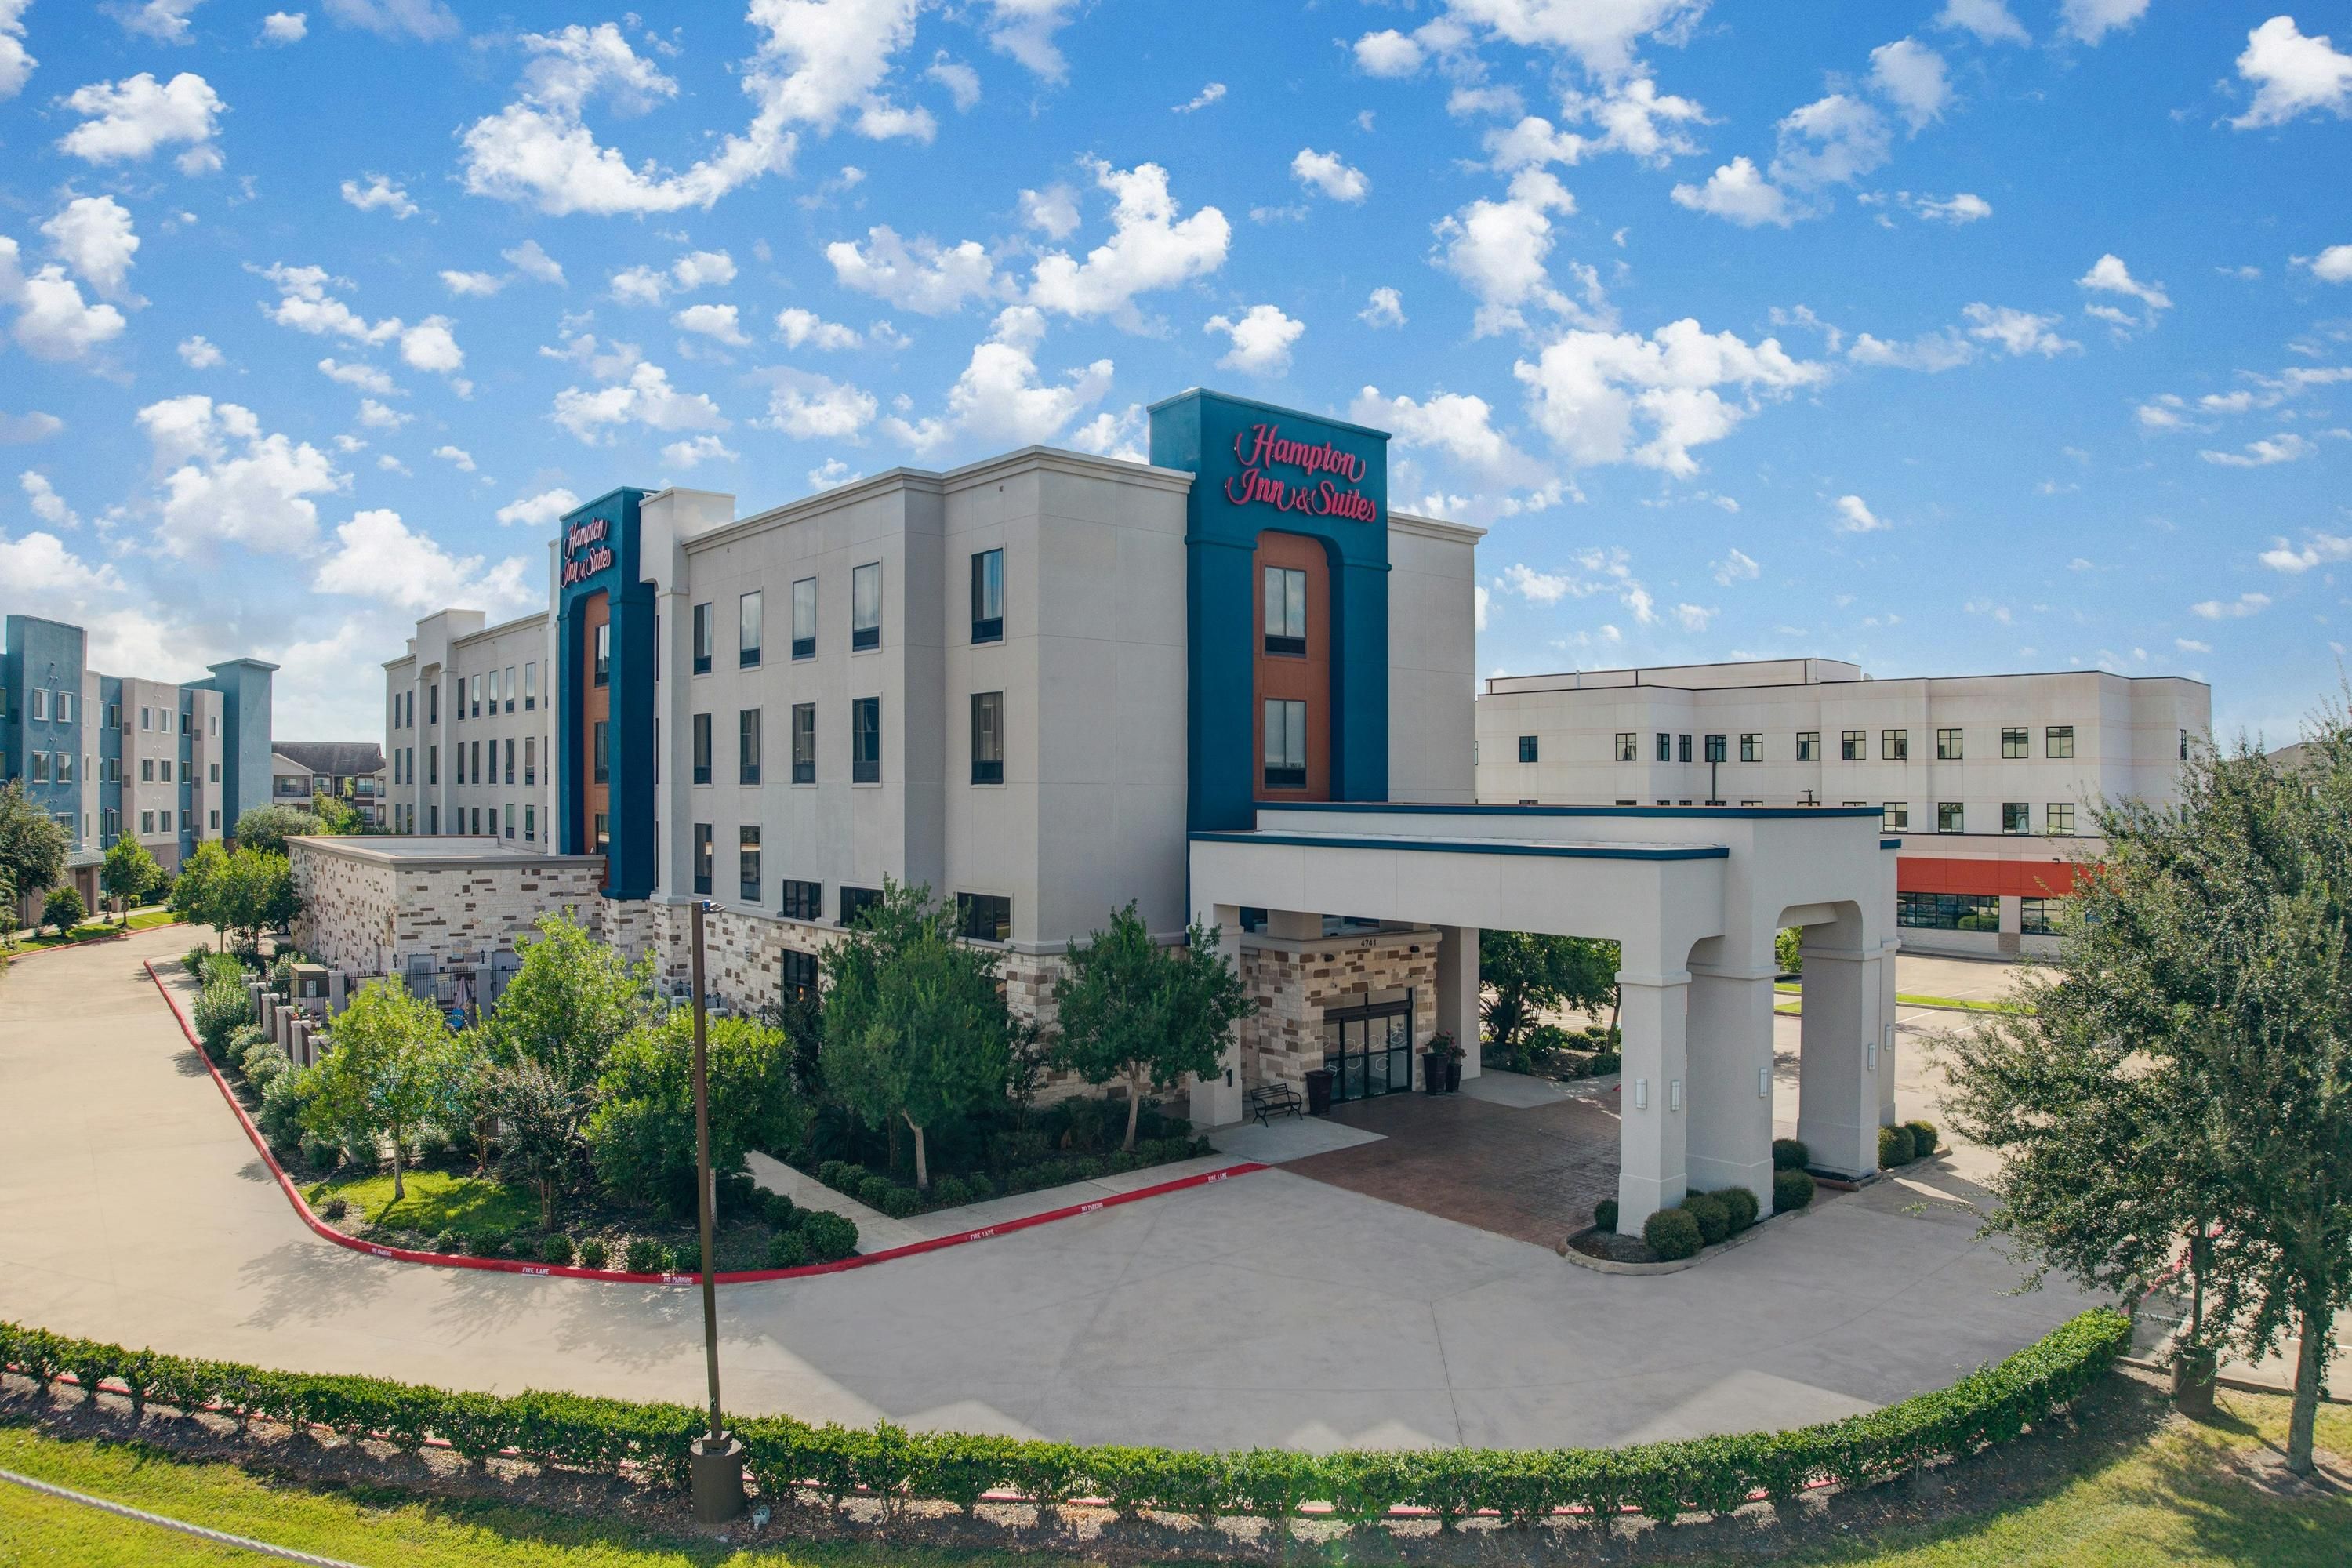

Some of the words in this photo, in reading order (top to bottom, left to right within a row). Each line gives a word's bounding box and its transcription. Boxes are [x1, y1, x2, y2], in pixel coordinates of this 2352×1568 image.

[1235, 423, 1366, 483] Hampton
[1226, 468, 1295, 511] Inn
[1296, 487, 1313, 515] &
[1311, 480, 1377, 522] Suites
[563, 517, 608, 560] Hampton
[561, 558, 581, 588] Inn
[586, 546, 611, 575] Suites
[1361, 938, 1377, 947] 4741
